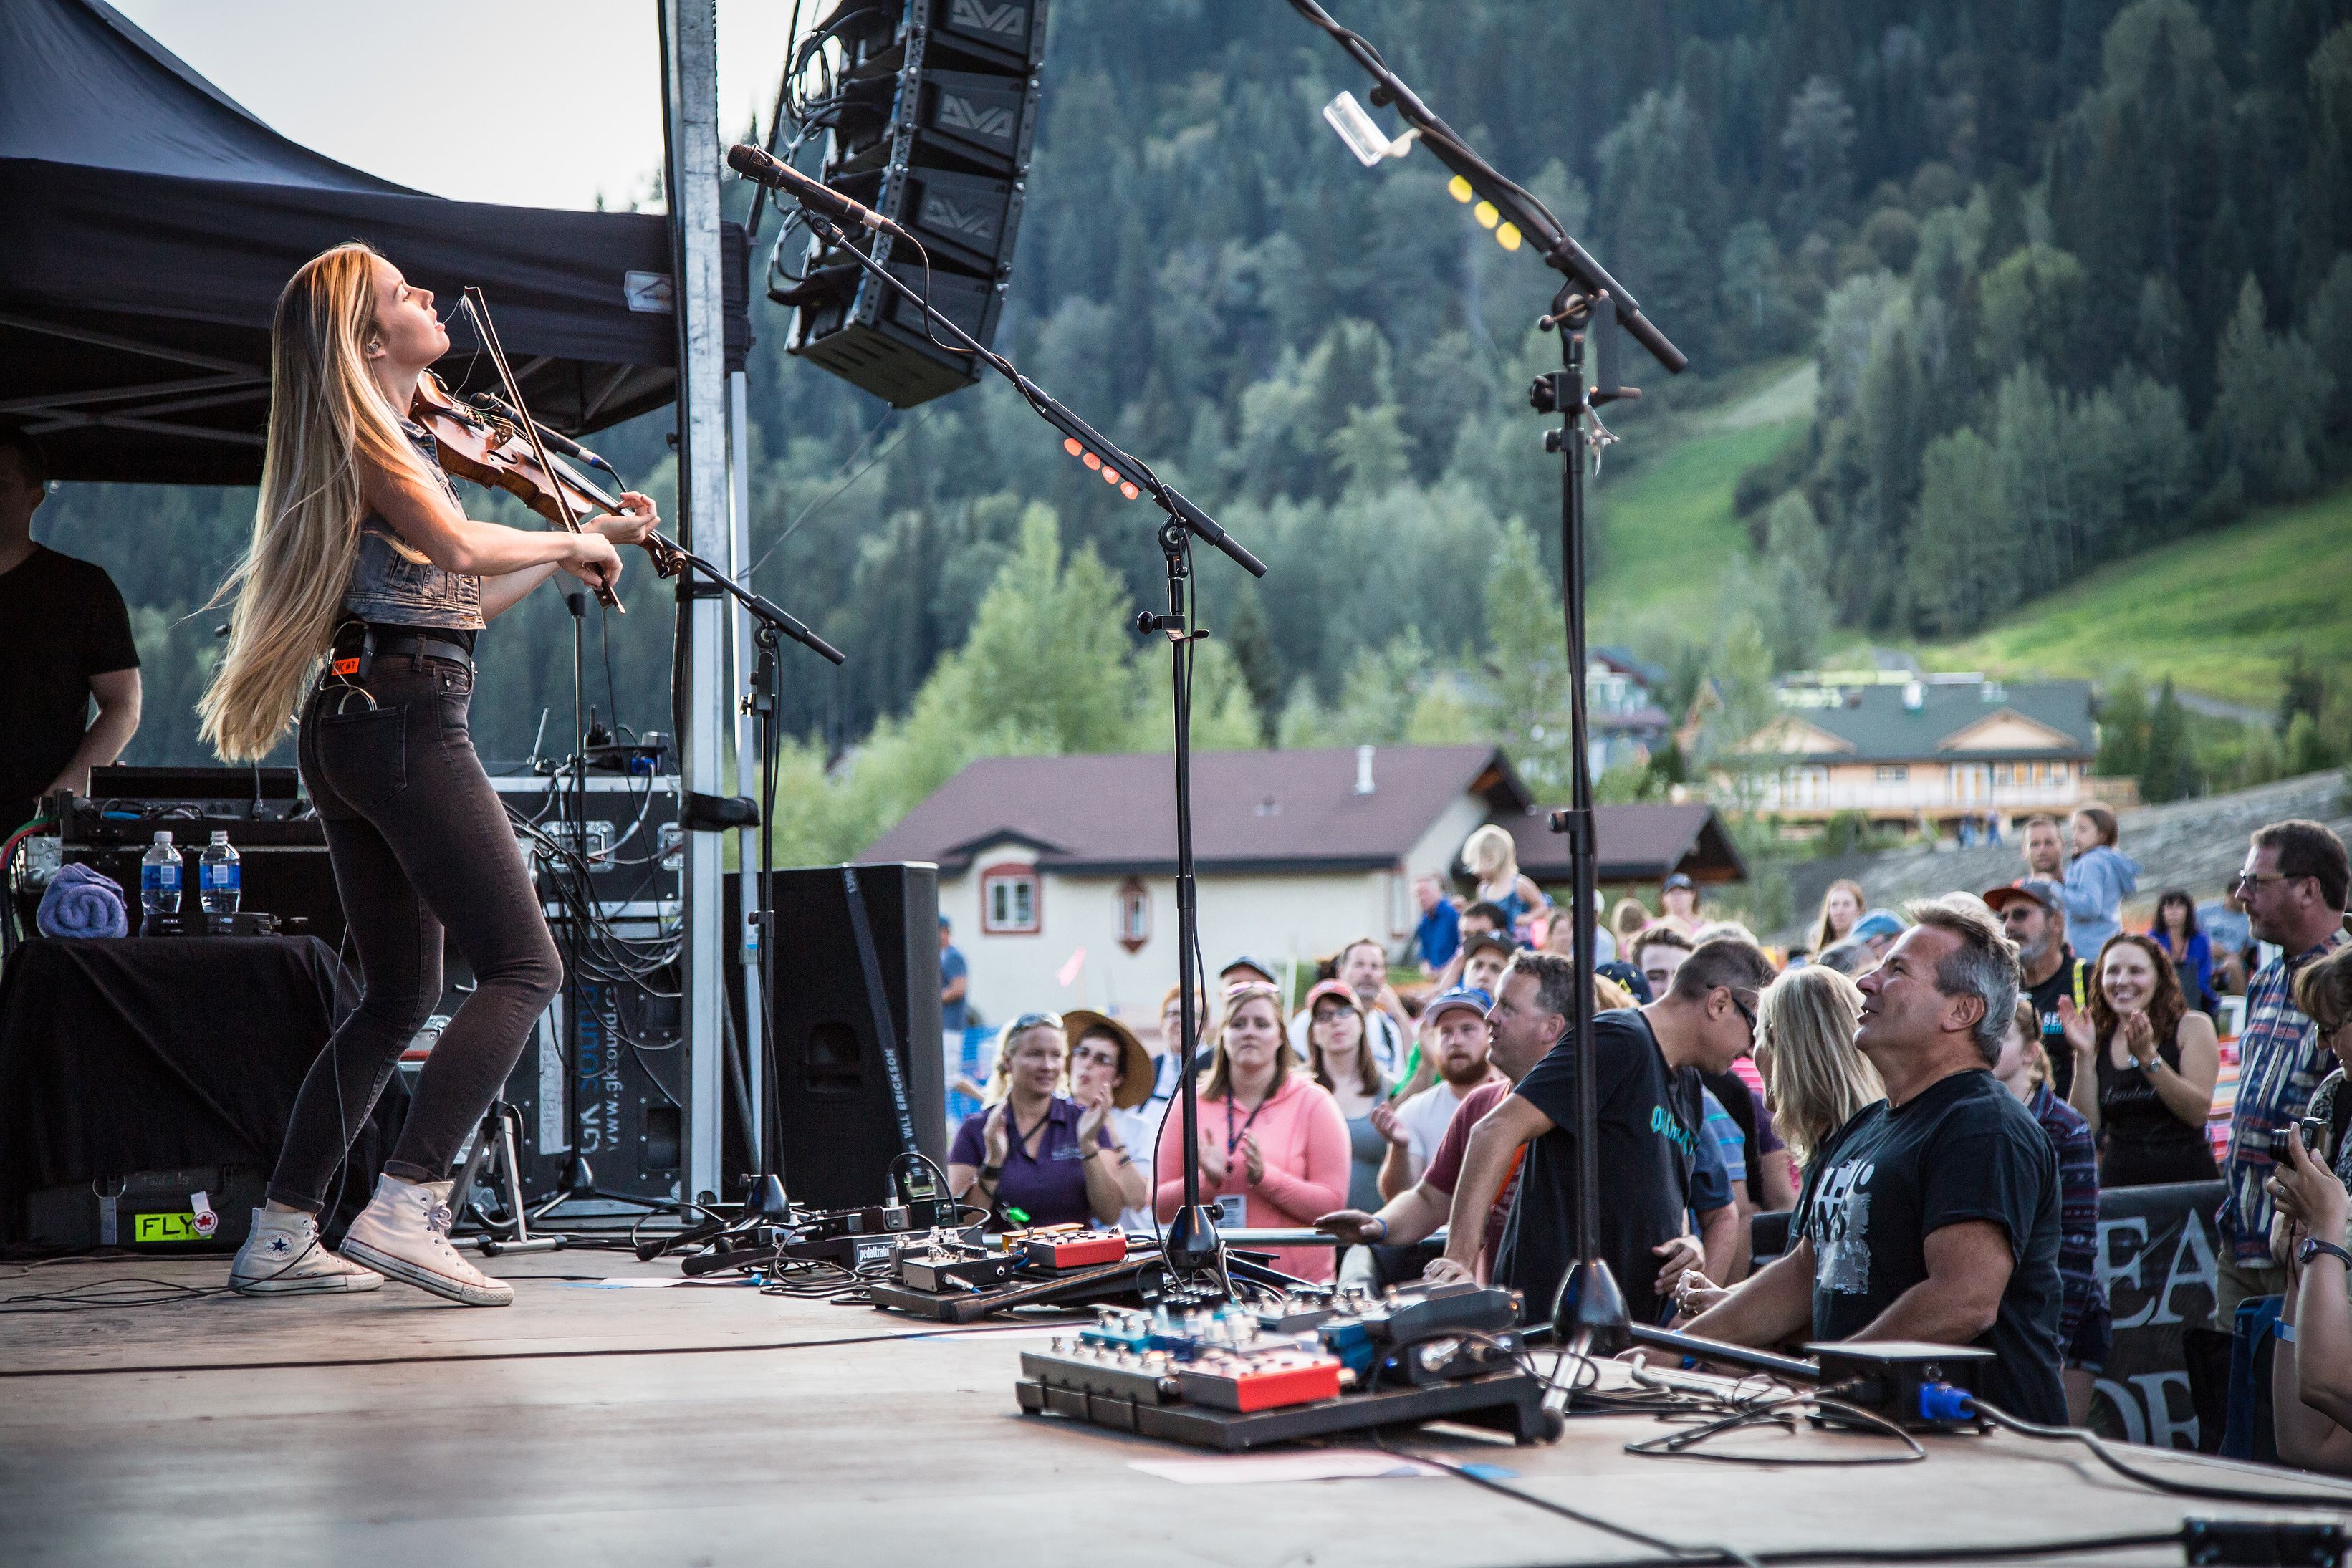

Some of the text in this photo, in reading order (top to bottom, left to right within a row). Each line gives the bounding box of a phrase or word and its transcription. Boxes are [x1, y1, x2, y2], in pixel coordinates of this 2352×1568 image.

[885, 1049, 908, 1110] ERICKSON
[901, 1114, 914, 1139] WLL
[142, 1215, 193, 1237] FLY
[859, 1246, 890, 1261] pedaltrain
